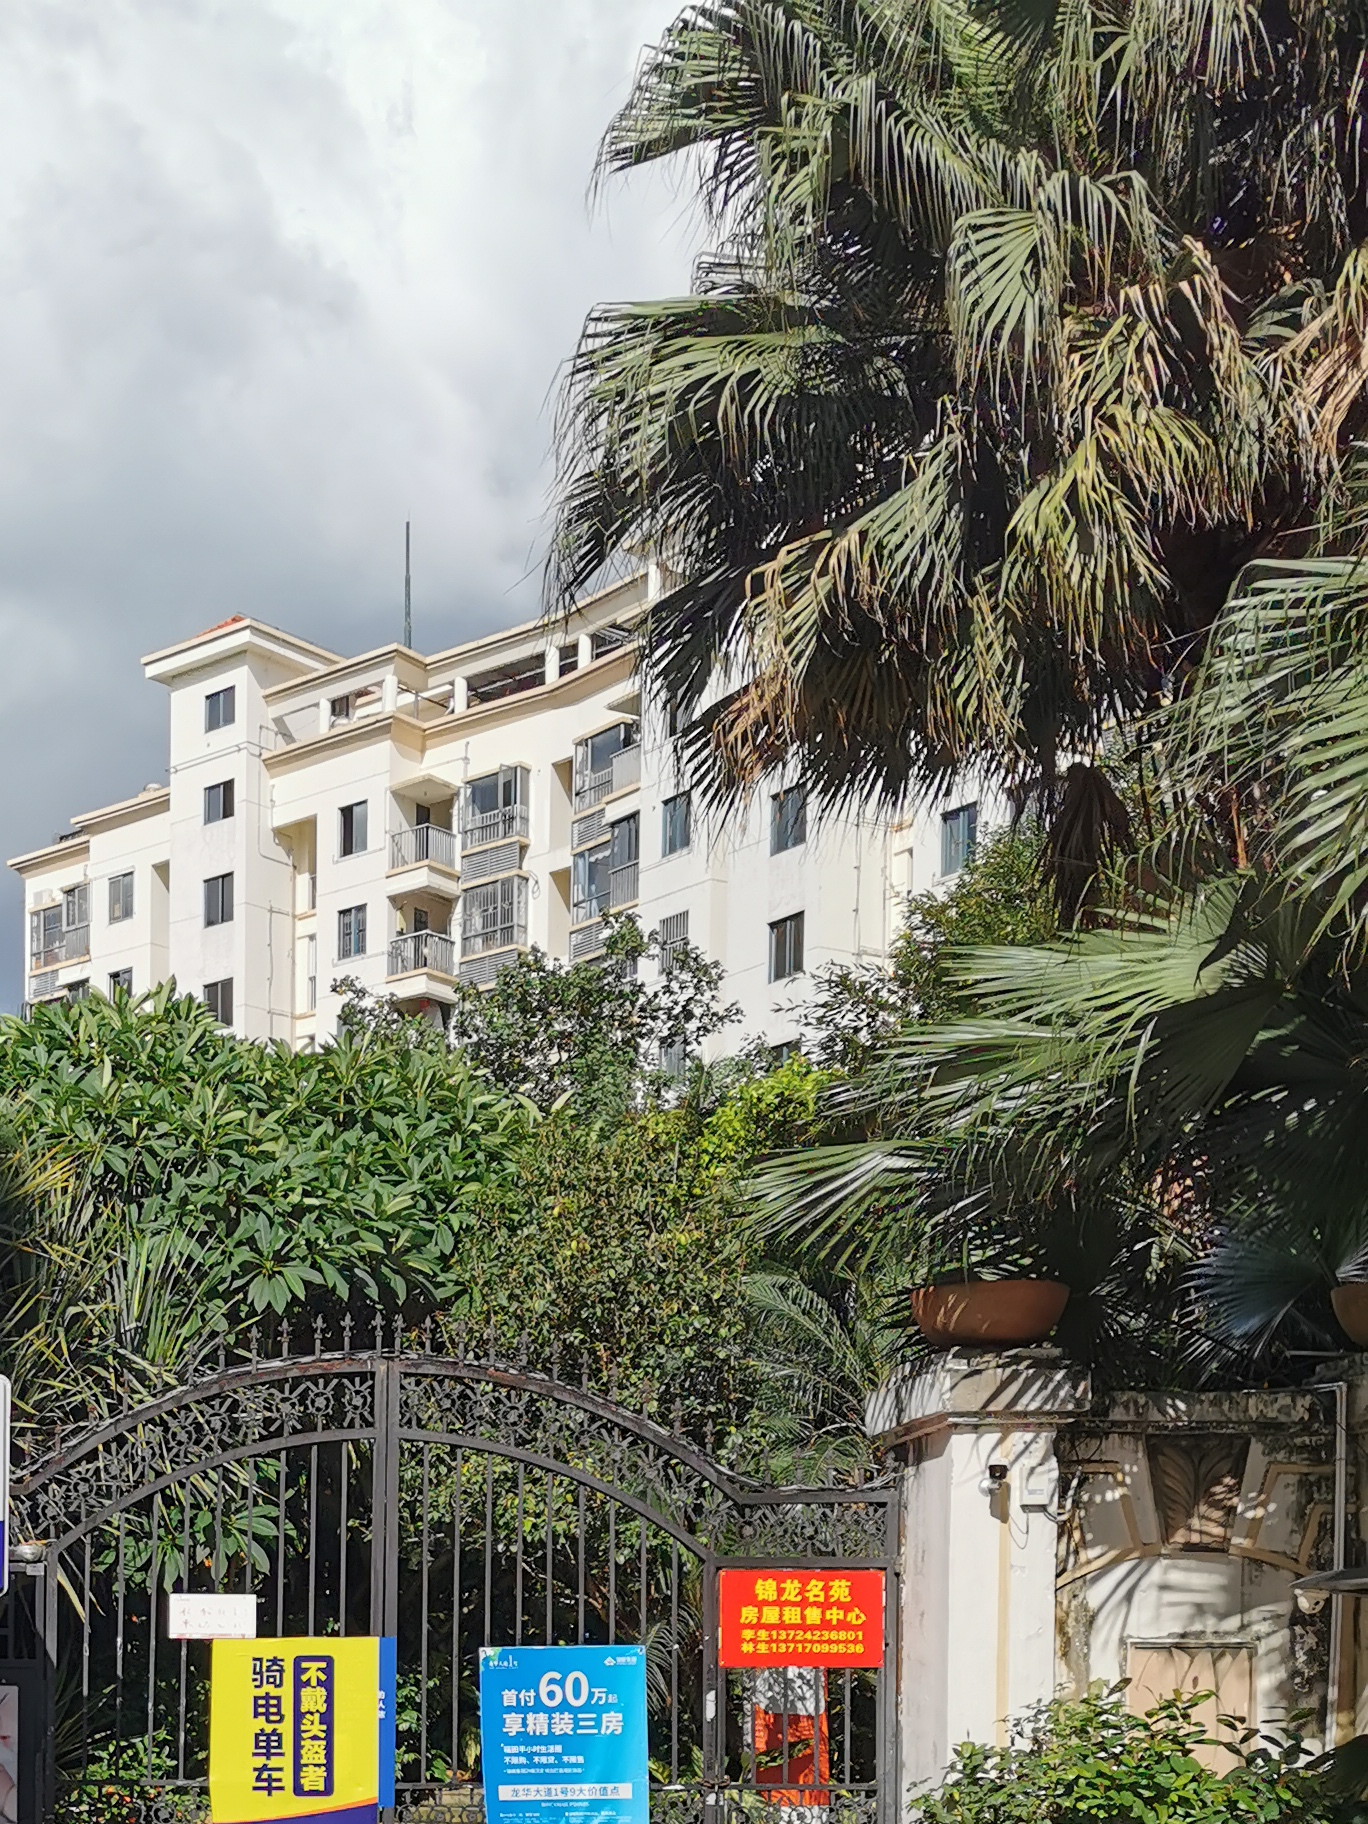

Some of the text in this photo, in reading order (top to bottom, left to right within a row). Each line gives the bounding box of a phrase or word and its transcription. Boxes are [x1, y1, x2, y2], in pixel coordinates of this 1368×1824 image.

[754, 1578, 852, 1602] 锦龙名苑
[739, 1605, 867, 1625] 房屋租售中心
[252, 1656, 286, 1797] 骑电单车
[300, 1661, 327, 1792] 不戴头盔者
[502, 1711, 624, 1736] 享精装三房
[511, 1786, 621, 1798] 龙华大道1号9大价值点
